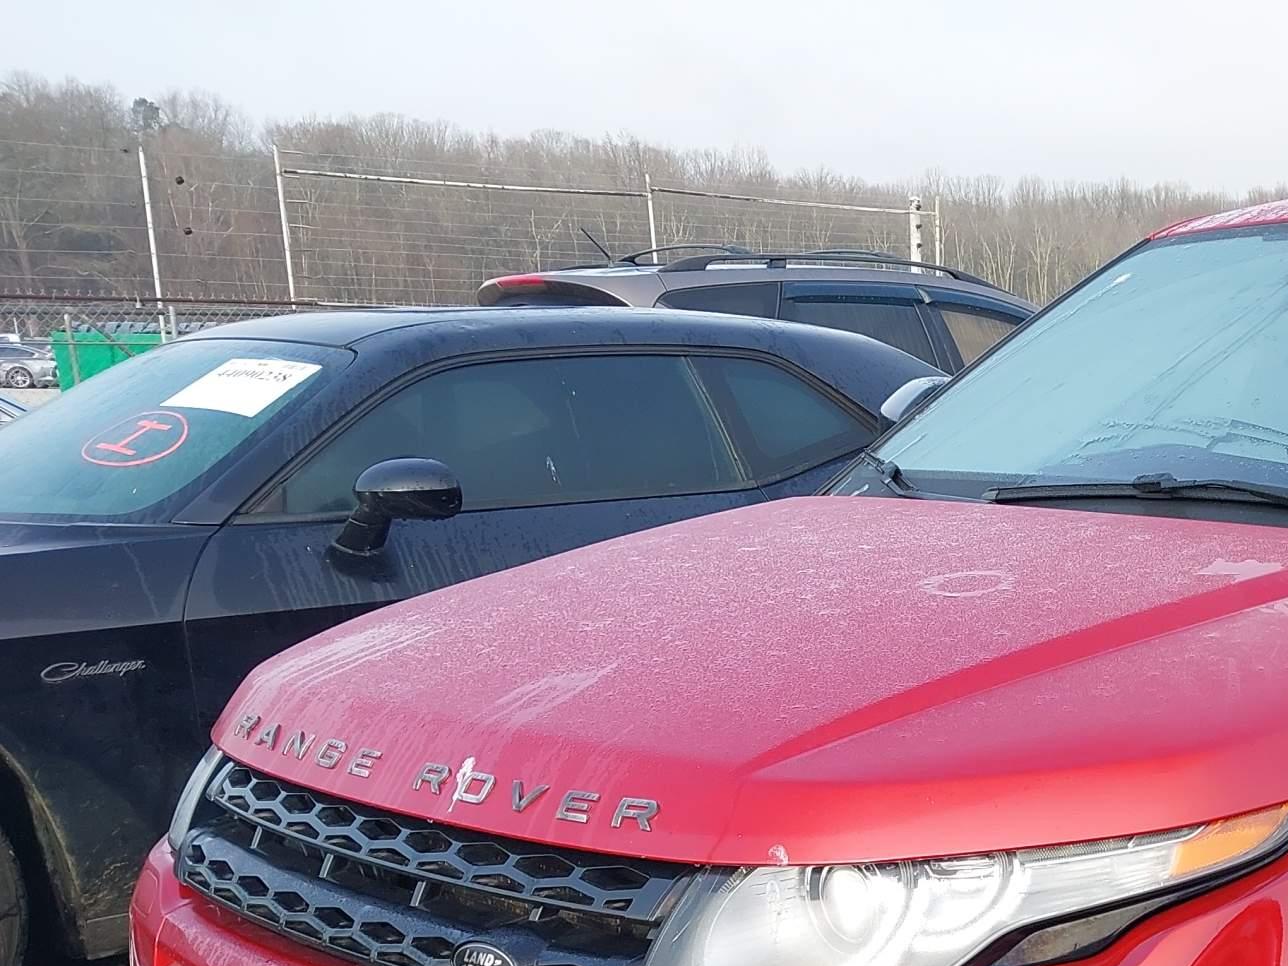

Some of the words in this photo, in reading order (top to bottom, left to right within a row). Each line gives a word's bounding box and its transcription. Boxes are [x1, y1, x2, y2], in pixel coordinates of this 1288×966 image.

[40, 659, 146, 682] Challenger
[232, 712, 384, 779] RANGE
[411, 761, 662, 832] ROVER
